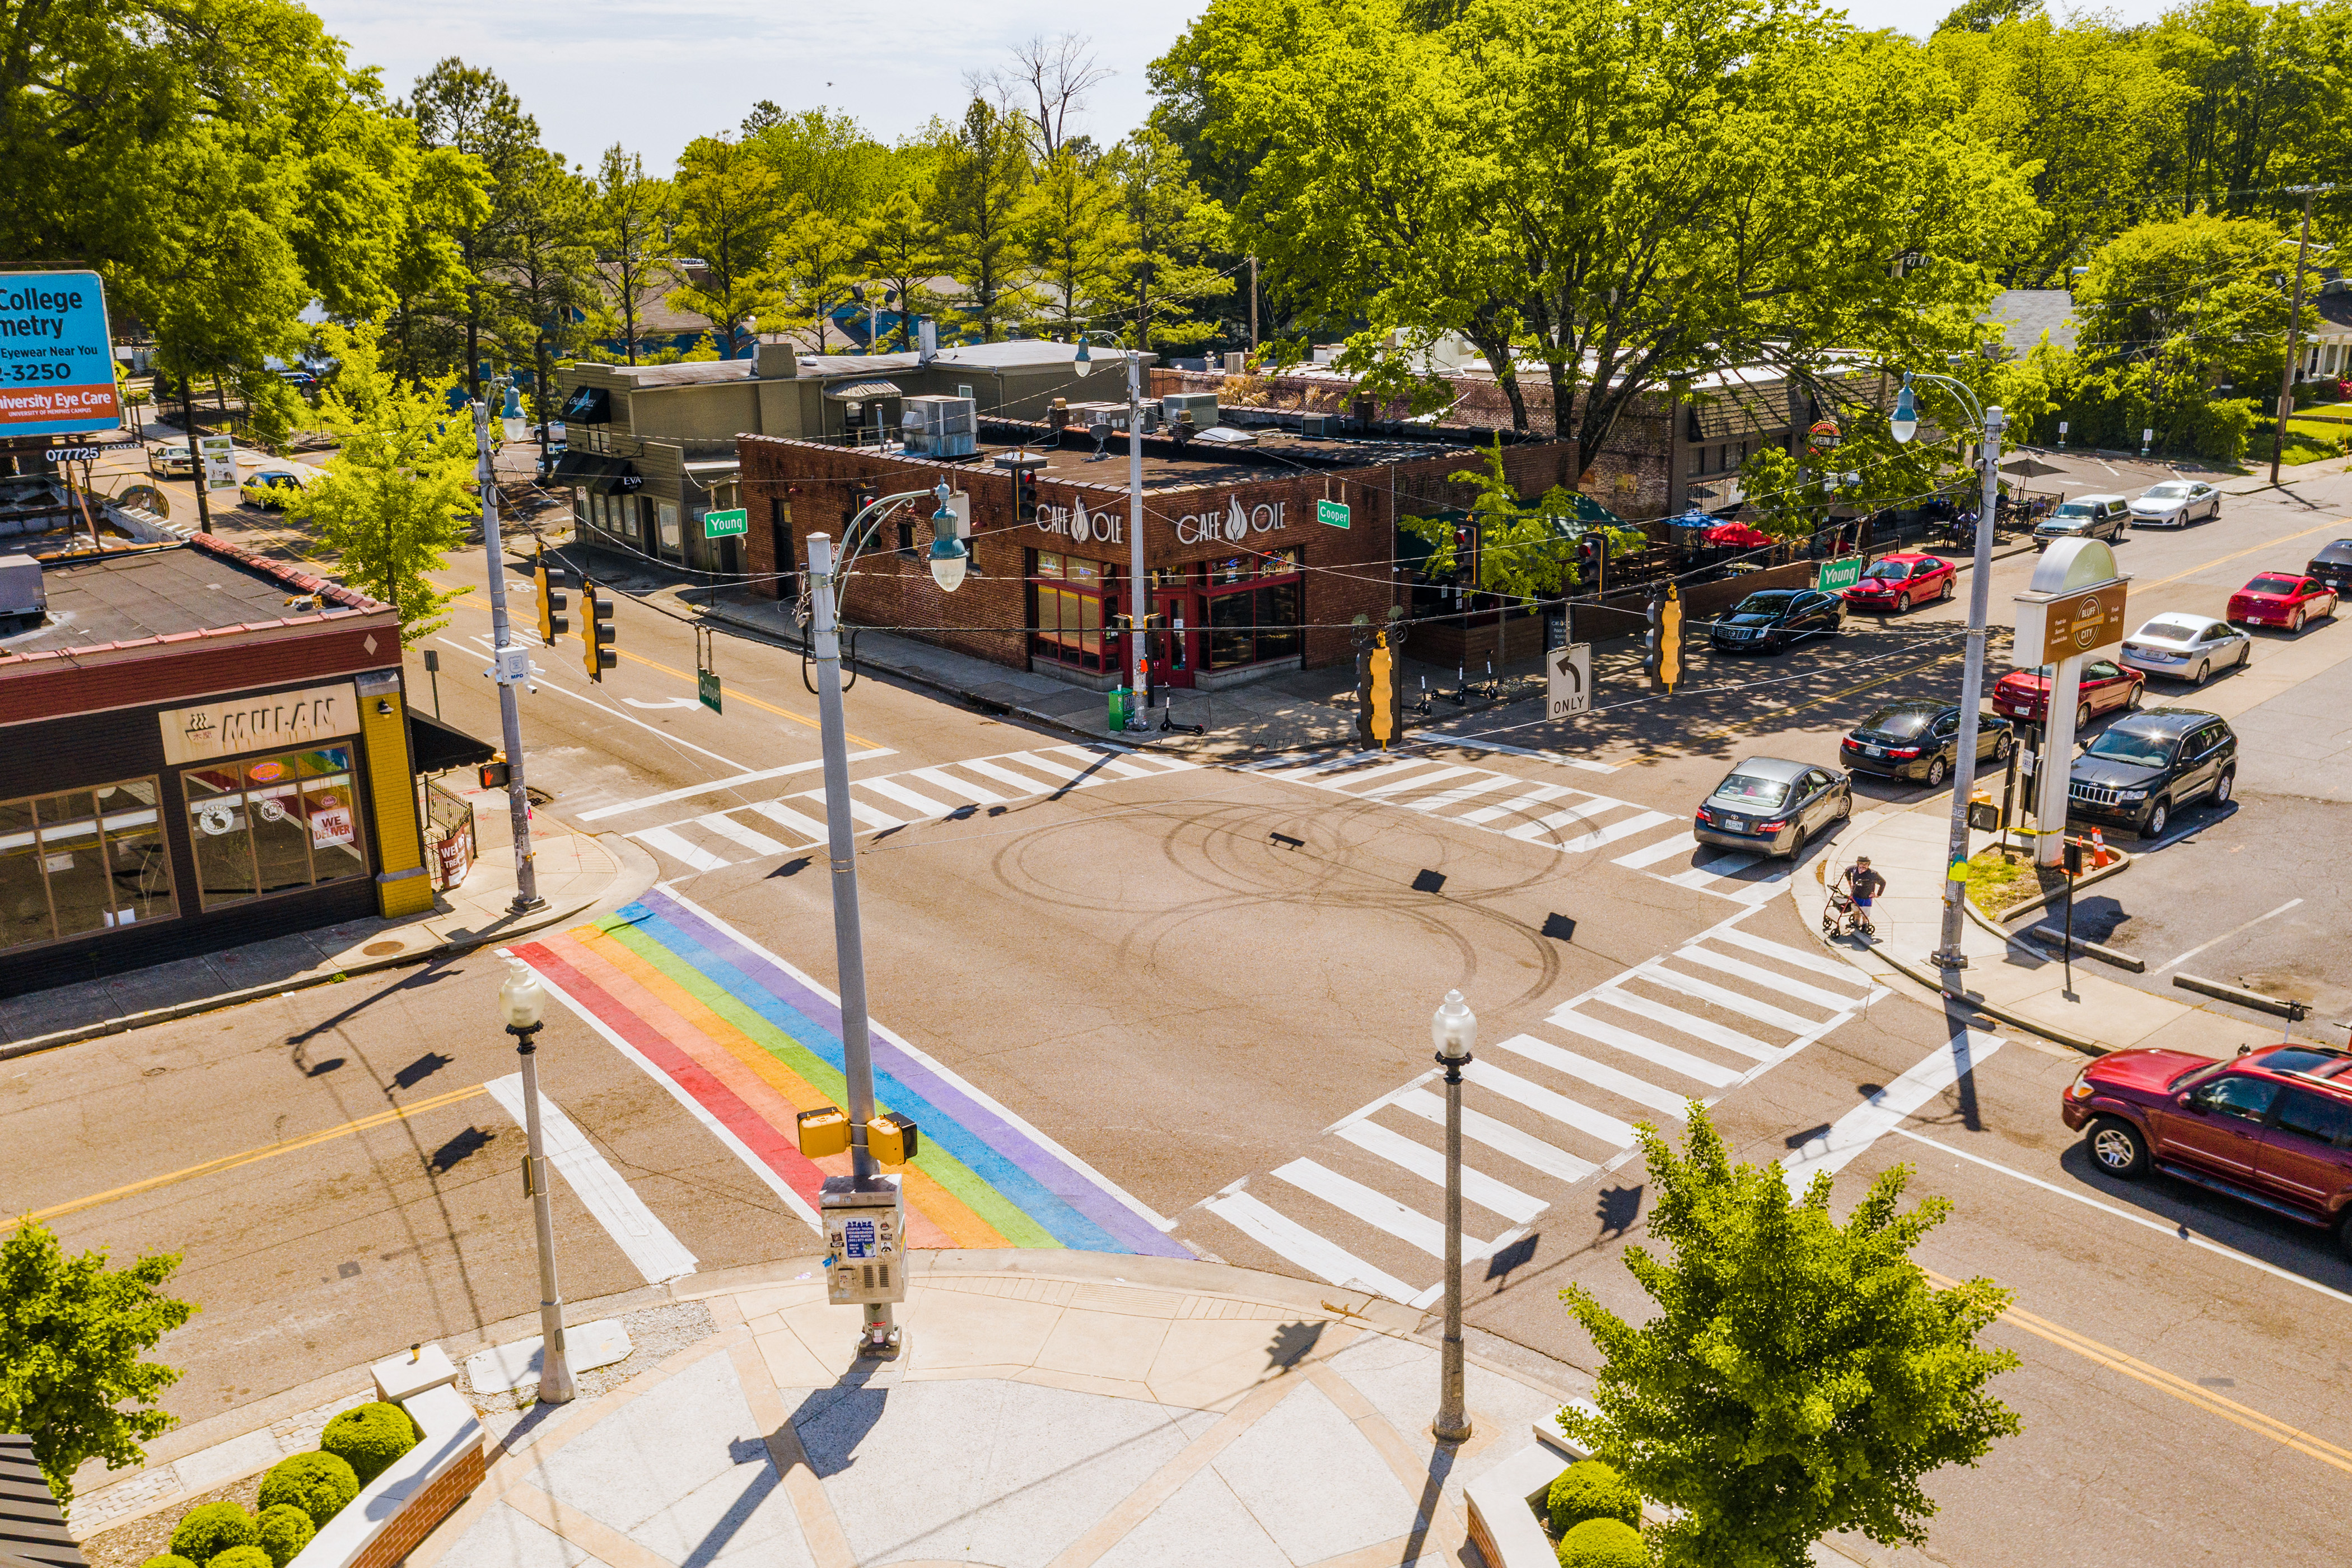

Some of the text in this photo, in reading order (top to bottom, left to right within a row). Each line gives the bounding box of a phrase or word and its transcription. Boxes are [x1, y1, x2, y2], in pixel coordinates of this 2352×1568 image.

[0, 287, 83, 314] College
[0, 315, 63, 339] metry
[1, 345, 98, 360] Eyewear Near You
[55, 393, 79, 408] Eye
[81, 391, 111, 405] Care
[569, 396, 596, 407] CHURCHILL
[45, 447, 100, 462] 077725
[105, 442, 141, 451] LAMAR
[624, 476, 642, 486] EVA
[1177, 502, 1286, 544] CAFE OLE
[1319, 506, 1348, 523] Cooper
[710, 518, 743, 531] Young
[1035, 503, 1124, 544] CAFE OLE
[1824, 567, 1856, 585] Young
[2082, 606, 2096, 618] BLUFF
[2081, 628, 2093, 640] CITY
[699, 676, 720, 704] Cooper
[1554, 695, 1584, 714] ONLY
[222, 698, 337, 743] MULAN
[321, 815, 342, 828] WE
[315, 824, 351, 841] DELIVER
